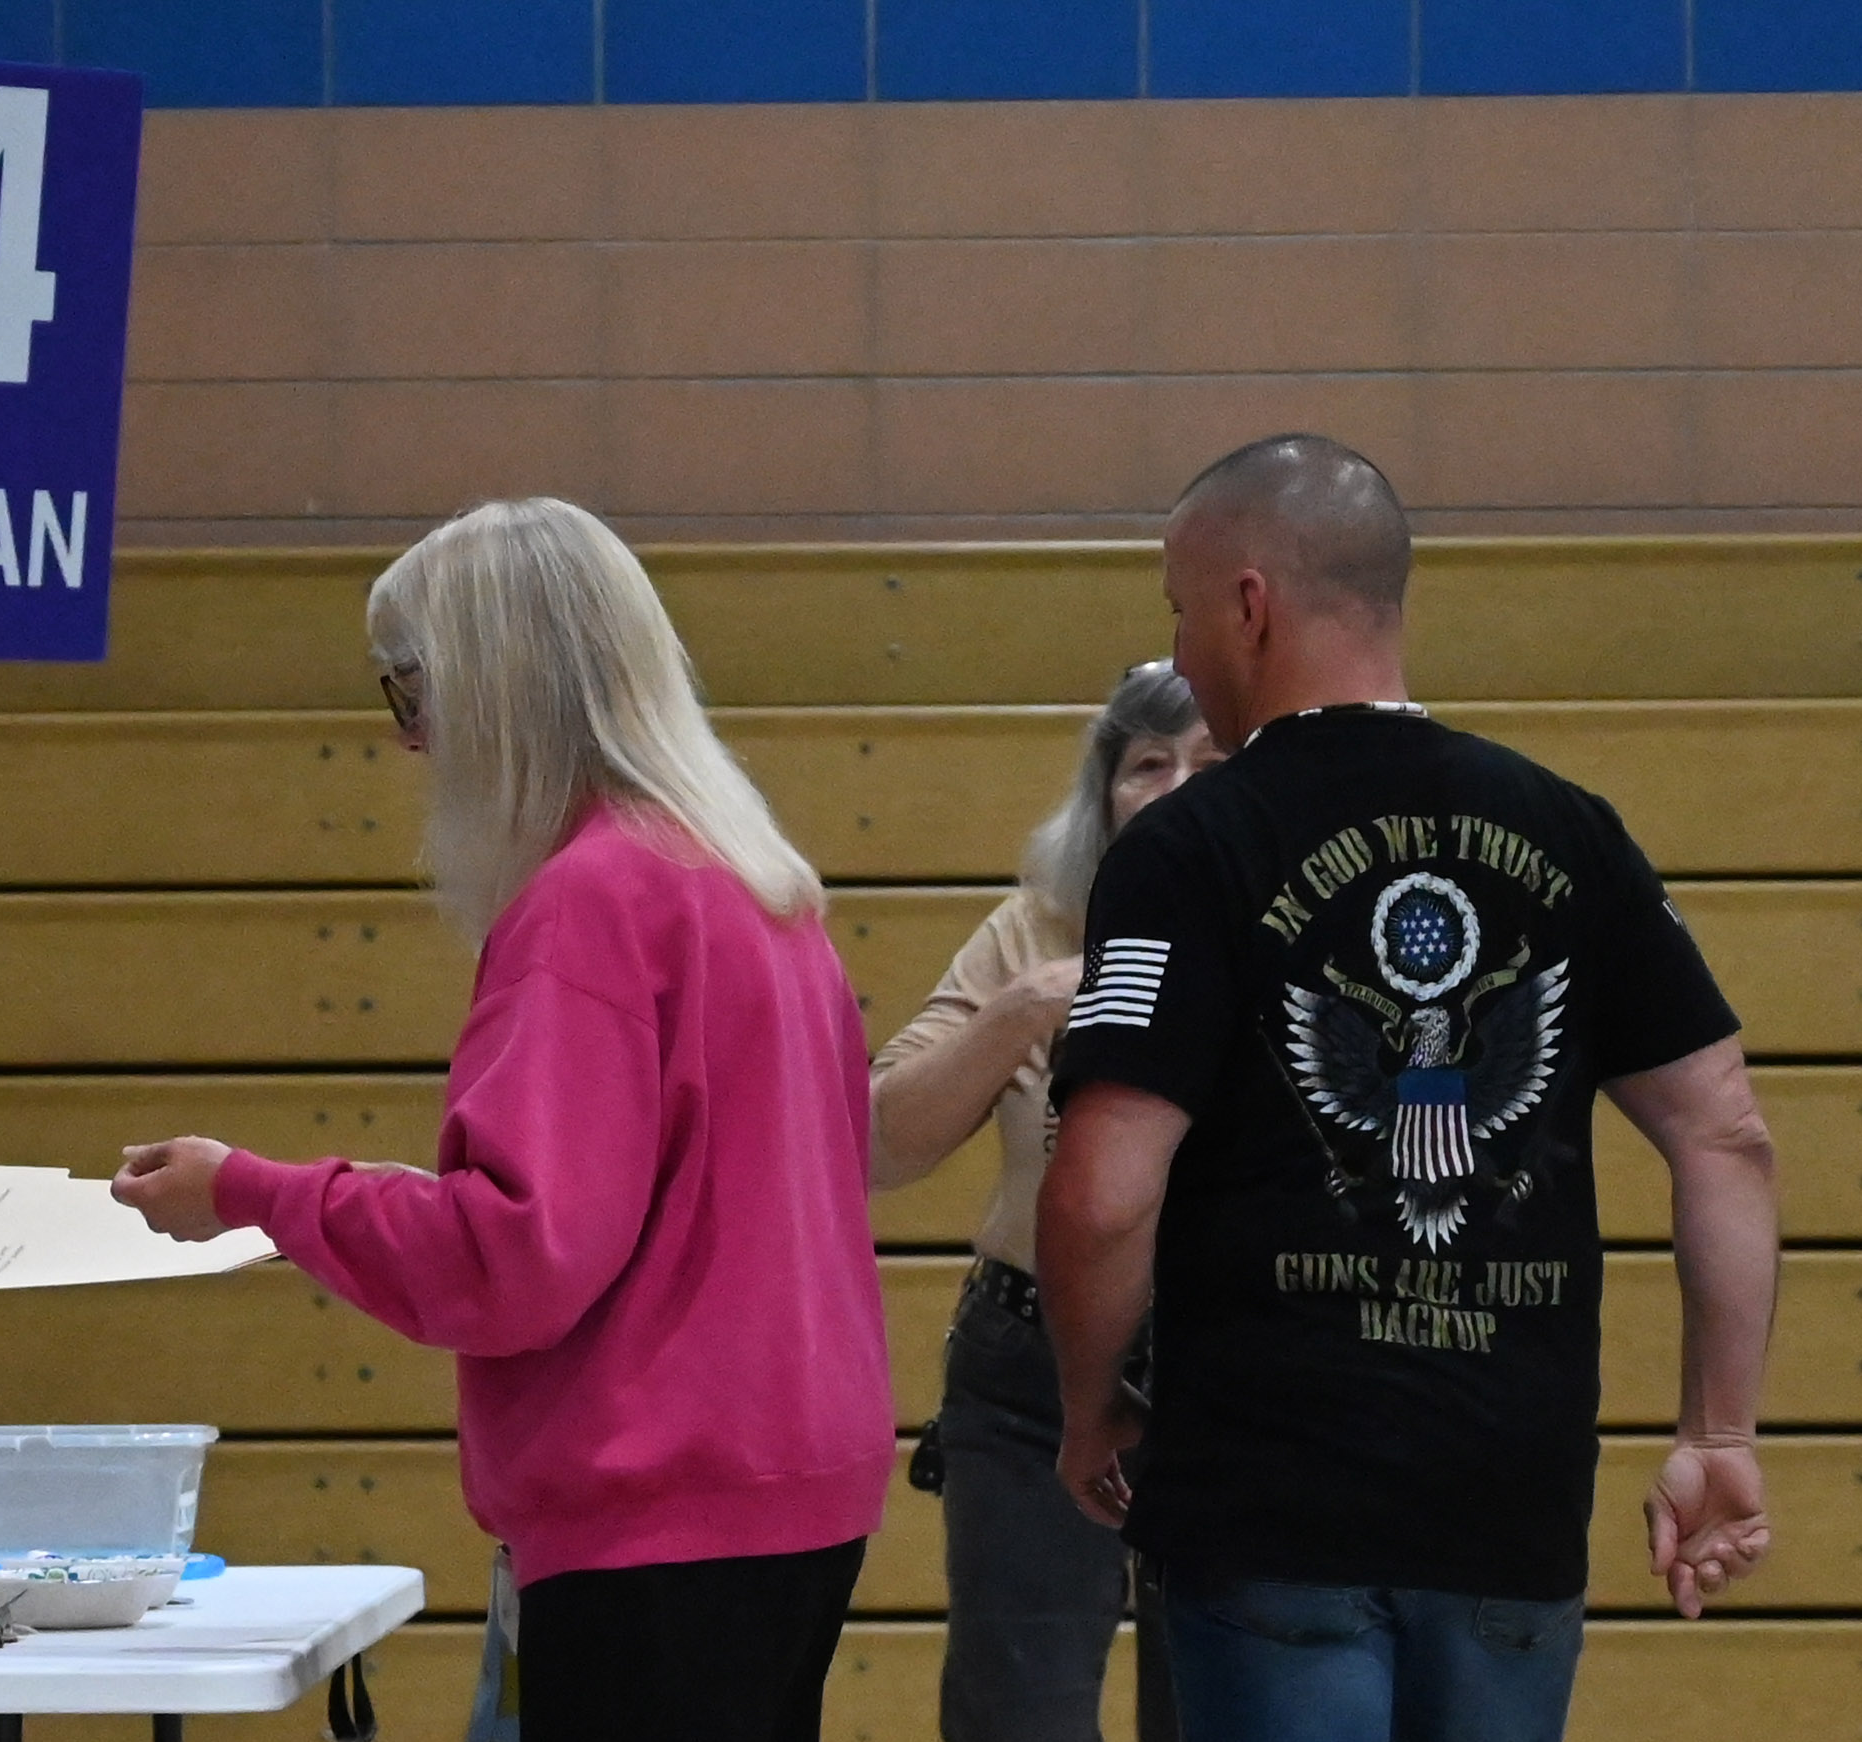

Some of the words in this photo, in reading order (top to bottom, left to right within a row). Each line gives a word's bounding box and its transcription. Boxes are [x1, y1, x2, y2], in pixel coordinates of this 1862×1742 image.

[1261, 881, 1315, 947] IN
[1300, 826, 1375, 900] GOD
[1372, 815, 1438, 863] WE
[1450, 814, 1574, 910] TRUST
[1274, 1251, 1380, 1294] GUNS
[1394, 1258, 1463, 1306] ARE
[1475, 1260, 1569, 1308] JUST
[1359, 1298, 1498, 1354] BACKUP
